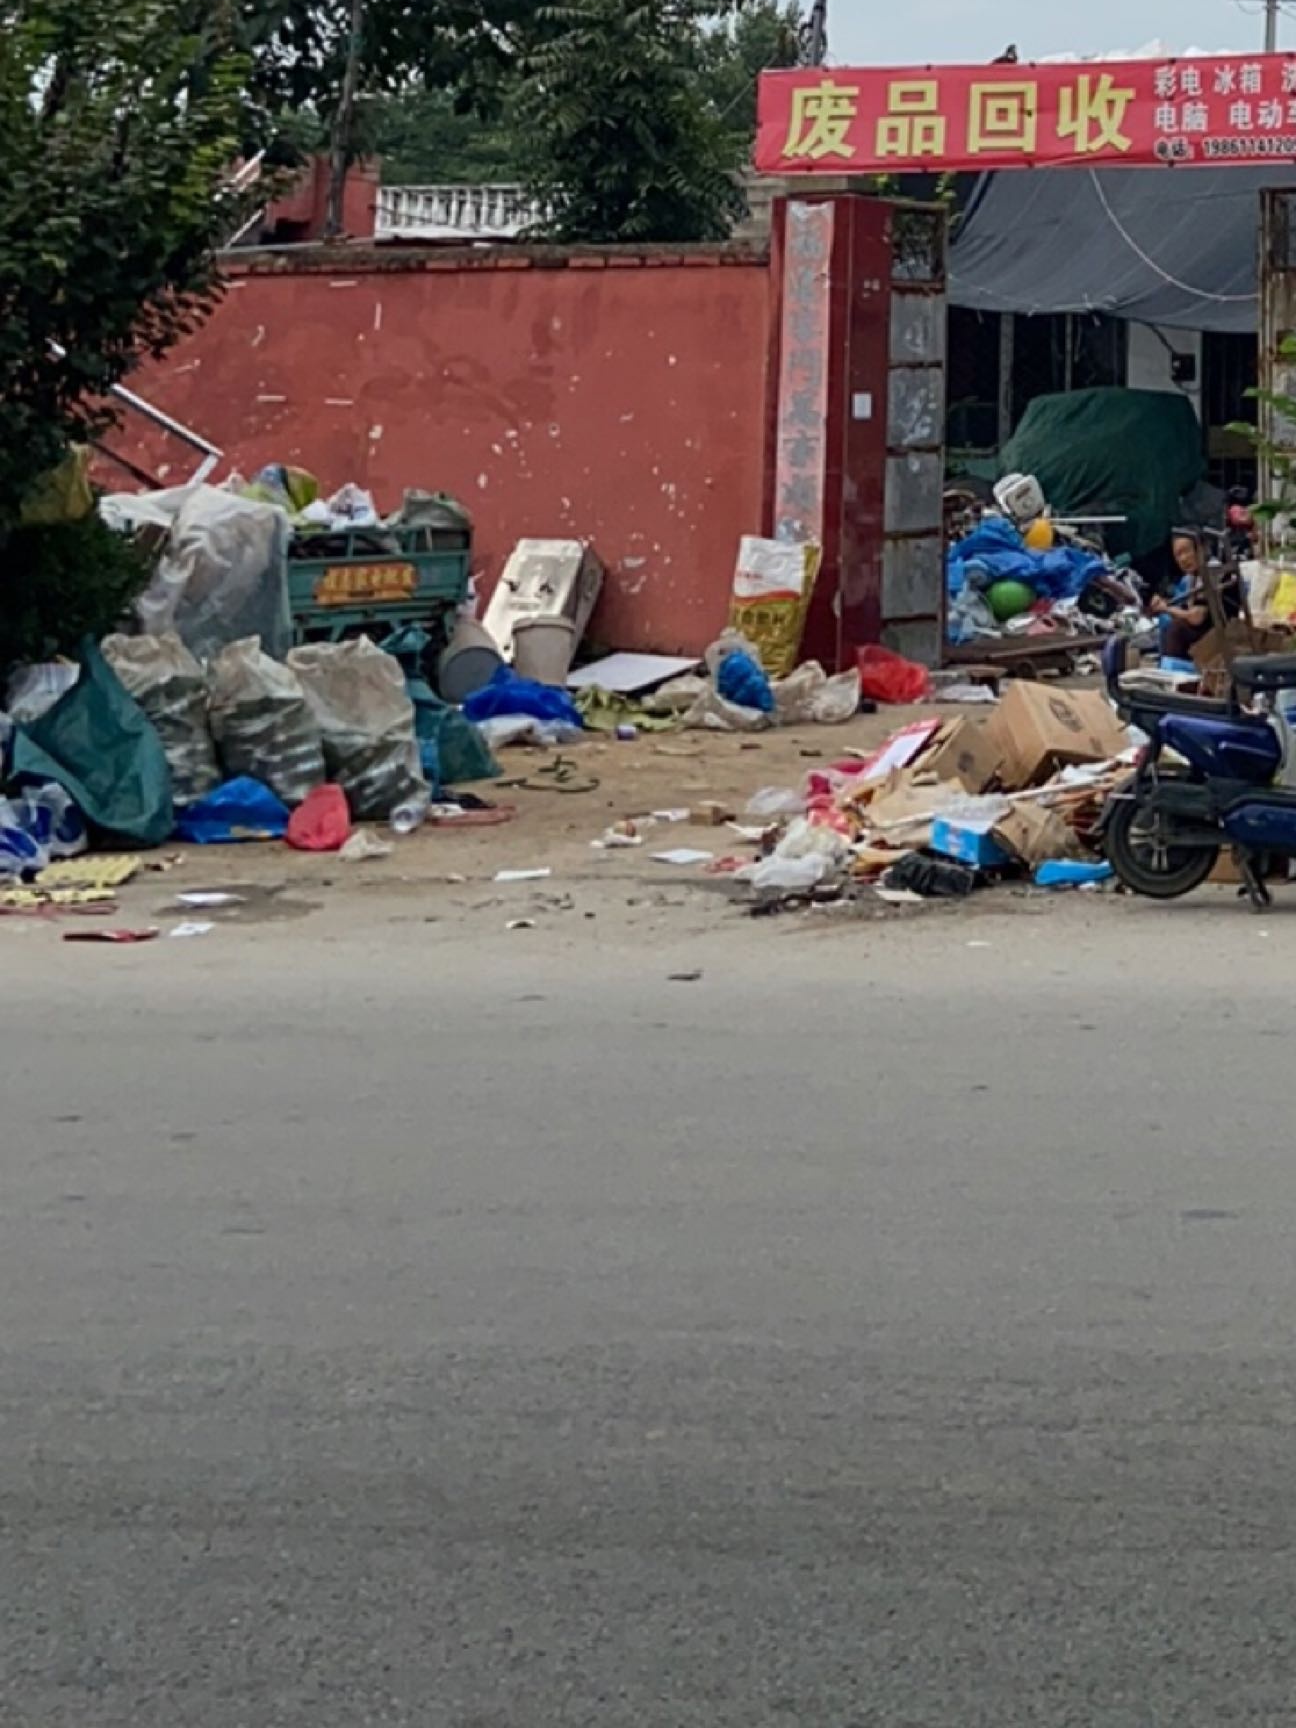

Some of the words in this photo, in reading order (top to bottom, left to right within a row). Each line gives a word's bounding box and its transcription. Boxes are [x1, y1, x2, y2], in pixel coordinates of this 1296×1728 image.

[1154, 65, 1202, 96] 彩电
[1214, 63, 1262, 94] 冰箱
[782, 73, 1137, 160] 废品回收
[1154, 101, 1208, 132] 电脑
